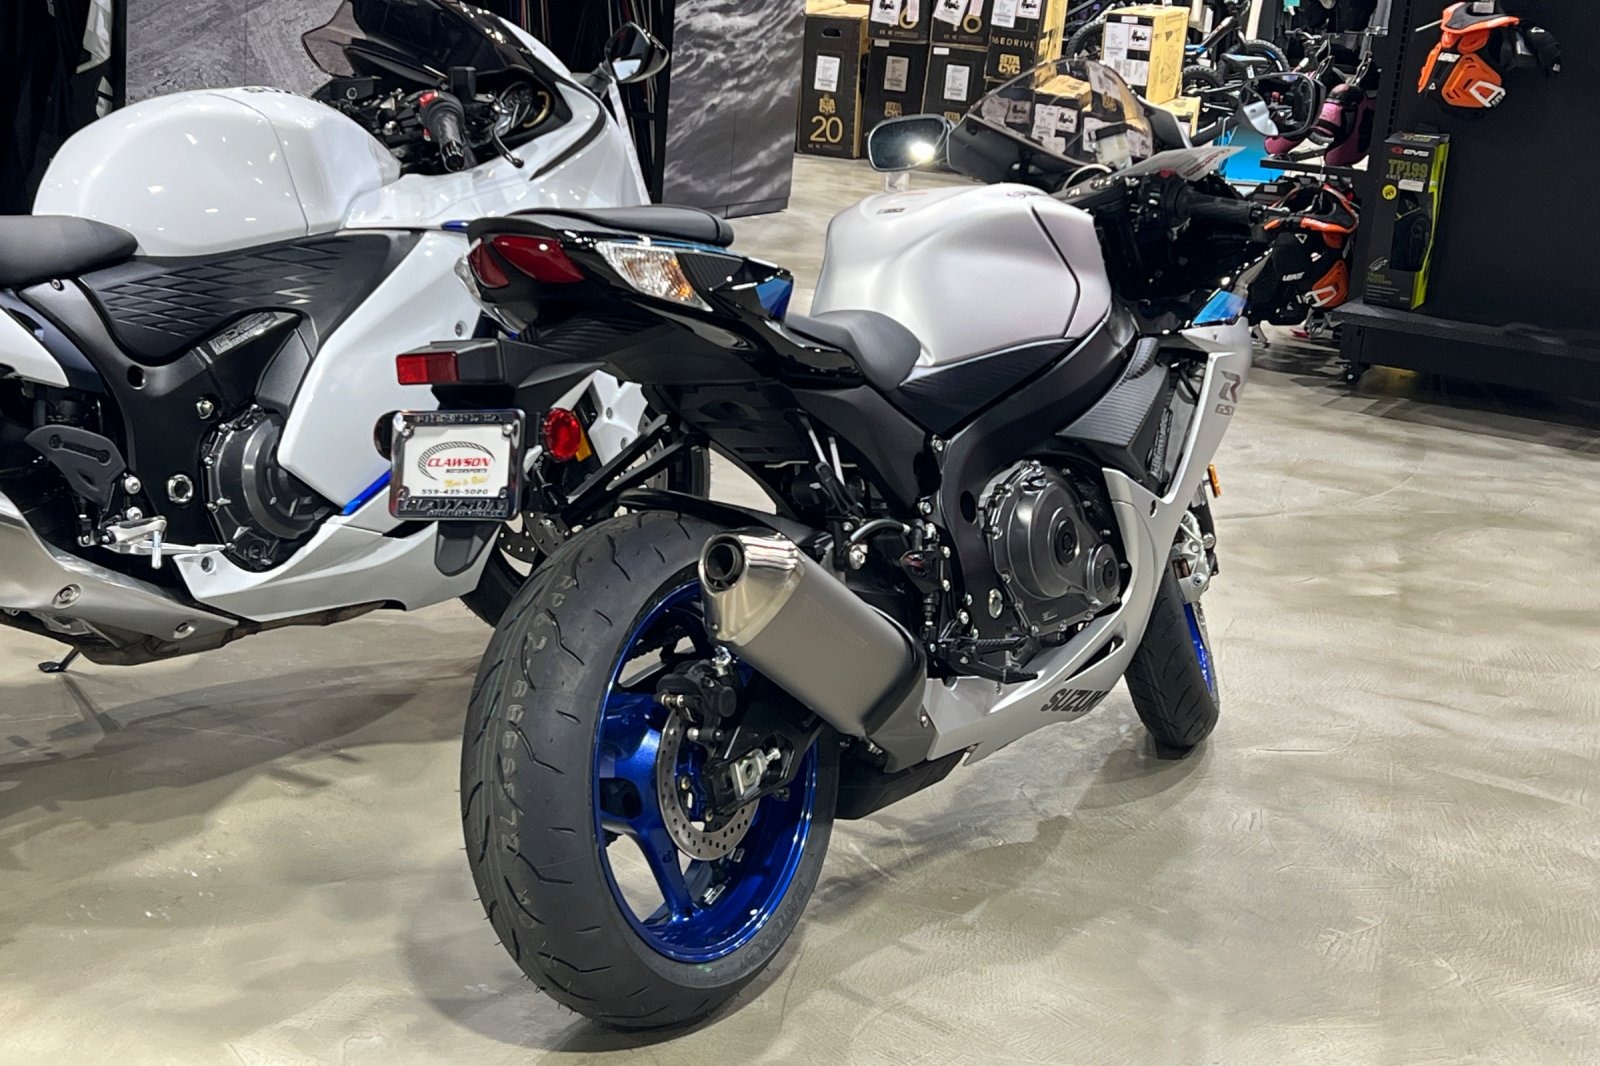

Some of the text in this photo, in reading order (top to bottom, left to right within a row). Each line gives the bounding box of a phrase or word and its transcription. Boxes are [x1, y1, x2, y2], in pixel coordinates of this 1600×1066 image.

[809, 115, 843, 143] 20
[1388, 159, 1429, 178] TP199
[427, 457, 491, 467] CLAWSON
[1040, 688, 1109, 712] SUZUK
